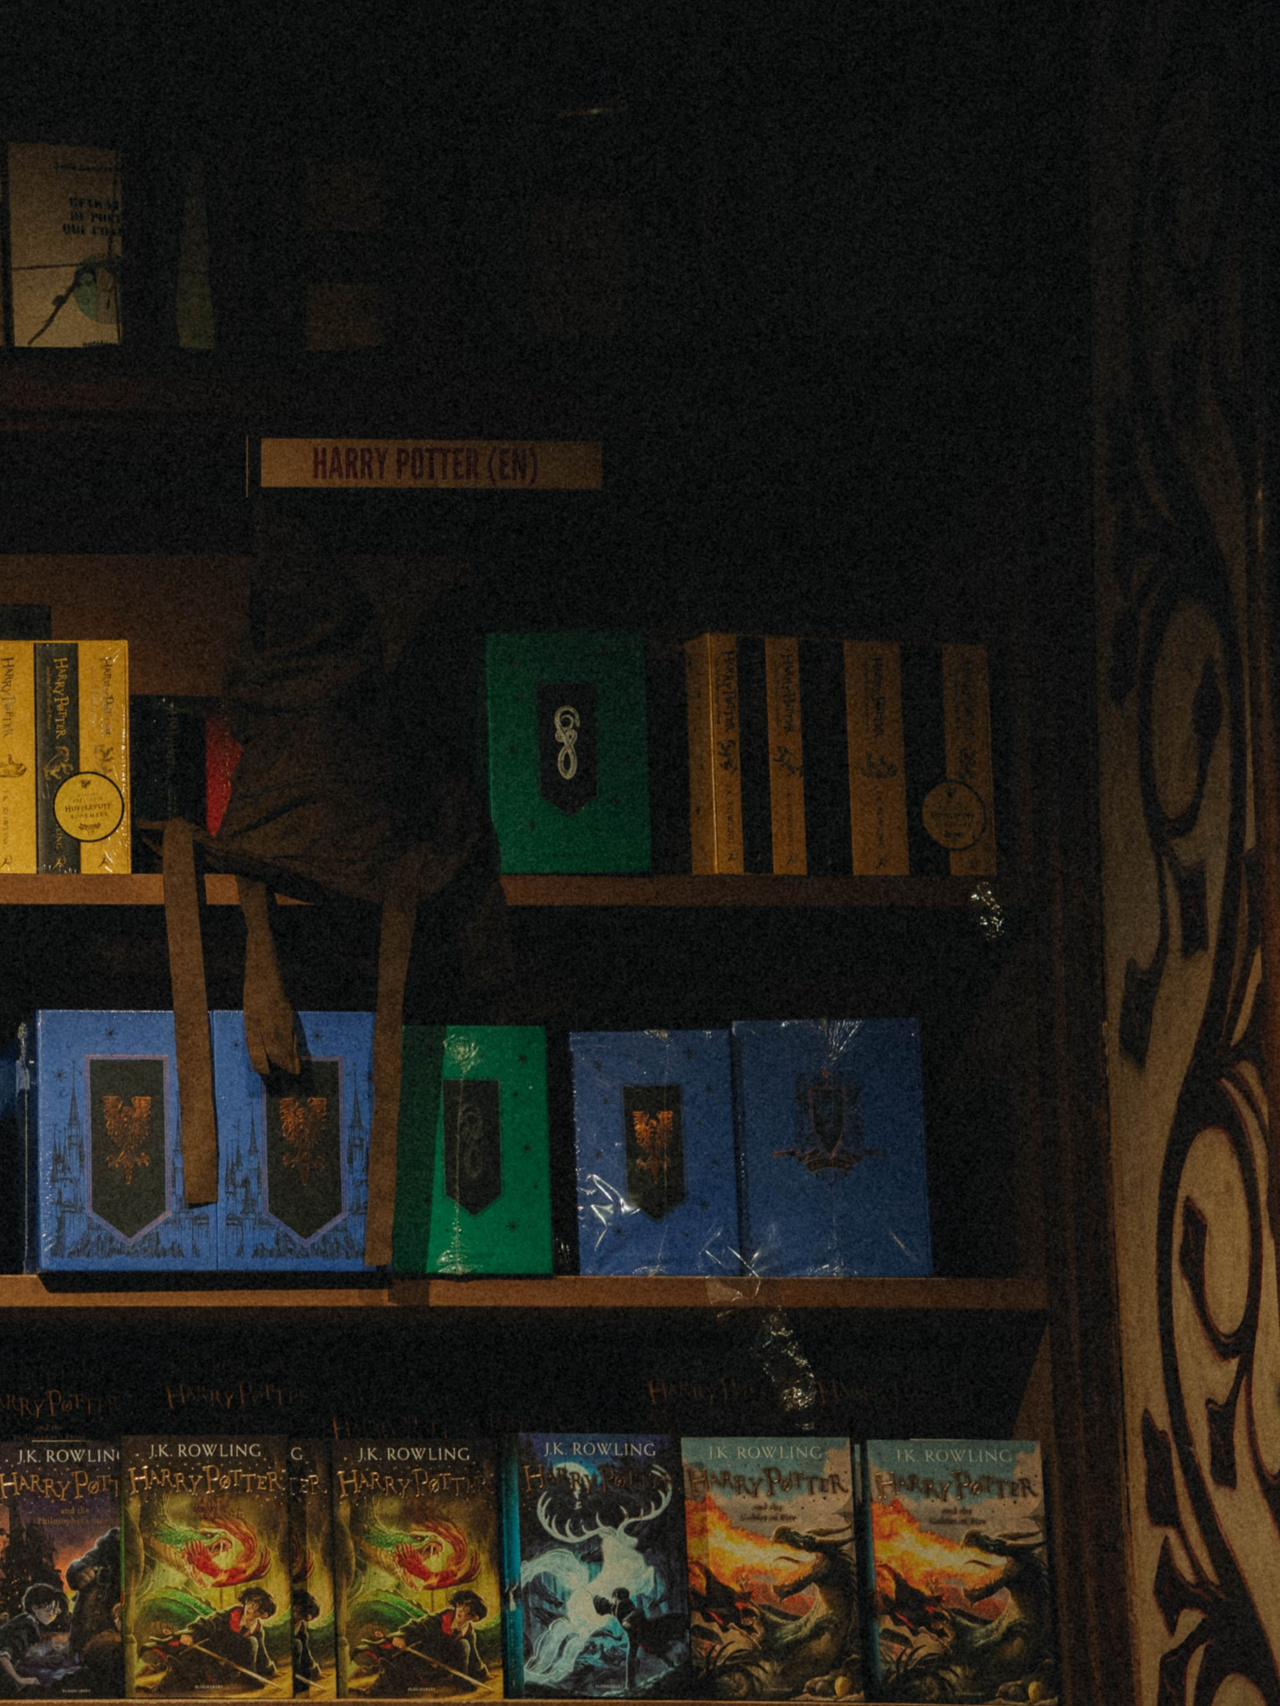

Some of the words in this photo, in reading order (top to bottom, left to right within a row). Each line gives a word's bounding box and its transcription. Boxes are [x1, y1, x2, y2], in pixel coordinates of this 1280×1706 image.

[313, 446, 388, 480] HARRY
[396, 447, 479, 481] POTTER
[489, 446, 539, 487] (EN)
[53, 657, 68, 695] HARRY
[55, 695, 70, 740] POTTER
[17, 1449, 41, 1465] J.K.
[149, 1444, 173, 1459] J.K.
[178, 1443, 262, 1458] ROWLING
[358, 1447, 383, 1462] J.K.
[387, 1447, 470, 1461] ROWLING
[544, 1442, 568, 1457] J.K.
[572, 1442, 657, 1457] ROWLING
[708, 1445, 732, 1460] J.K.
[737, 1445, 822, 1460] ROWLING
[896, 1449, 920, 1463] J.K.
[925, 1449, 1013, 1463] ROWLING
[71, 1470, 119, 1500] POTT
[128, 1465, 203, 1496] HARRY
[202, 1464, 286, 1495] POTTER
[337, 1469, 412, 1499] HARRY
[522, 1463, 598, 1494] HARRY
[687, 1468, 764, 1498] HARRY
[762, 1466, 849, 1496] POTTER
[874, 1470, 952, 1502] HARRY
[951, 1470, 1039, 1499] POTTER
